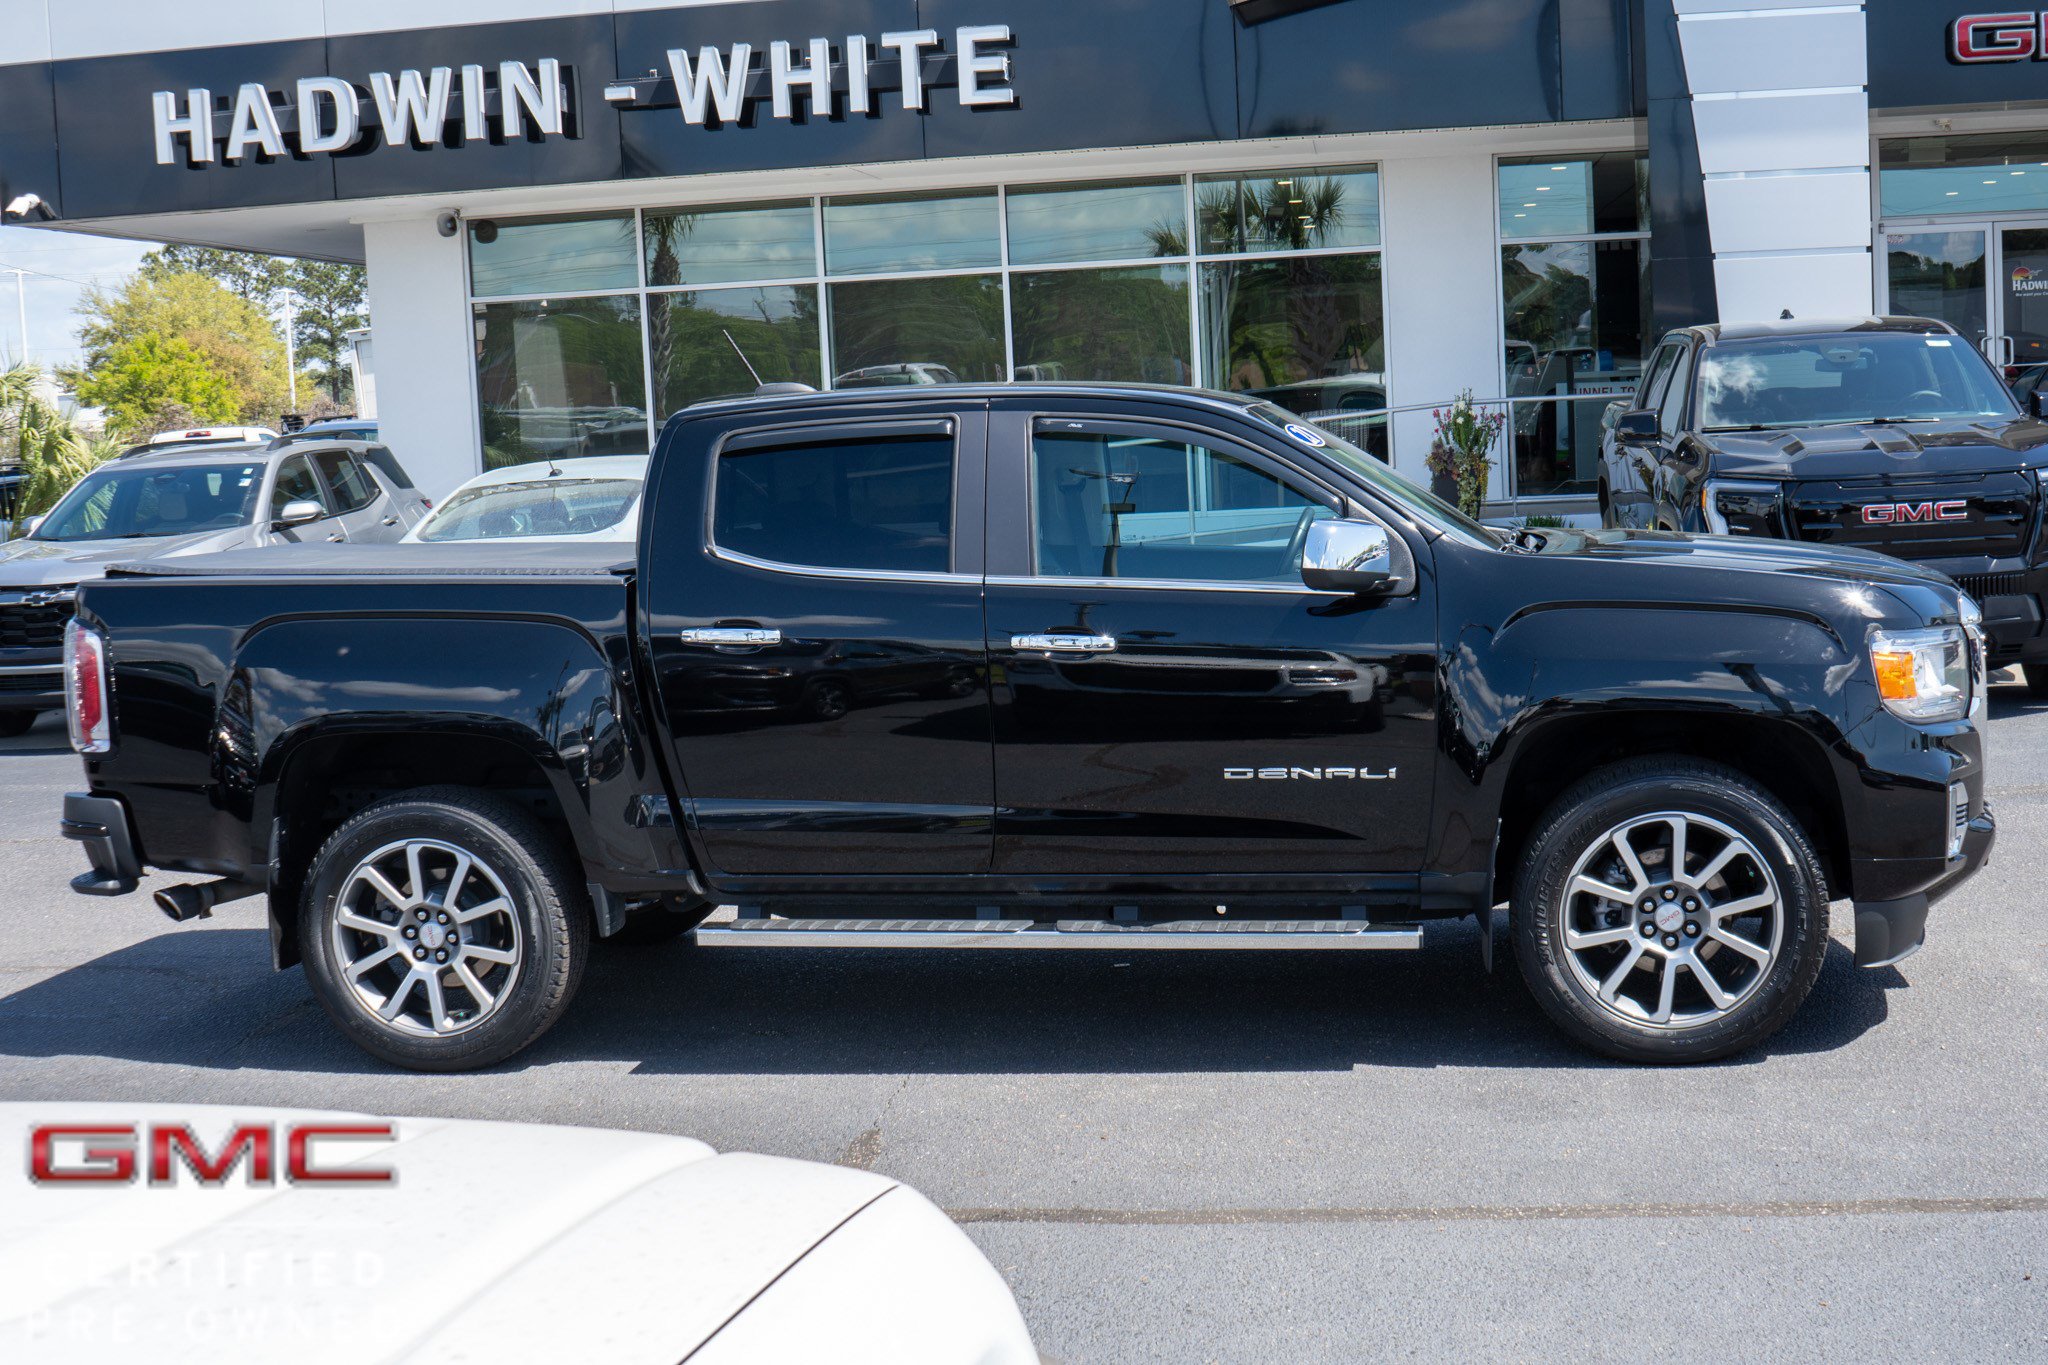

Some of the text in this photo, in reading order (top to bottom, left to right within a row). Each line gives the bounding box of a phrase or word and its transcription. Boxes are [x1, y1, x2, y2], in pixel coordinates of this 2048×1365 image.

[1953, 11, 2048, 63] G
[152, 57, 563, 165] HADWIN
[665, 25, 1014, 125] WHITE
[1862, 500, 1967, 524] GMC
[1224, 767, 1397, 780] DENALI
